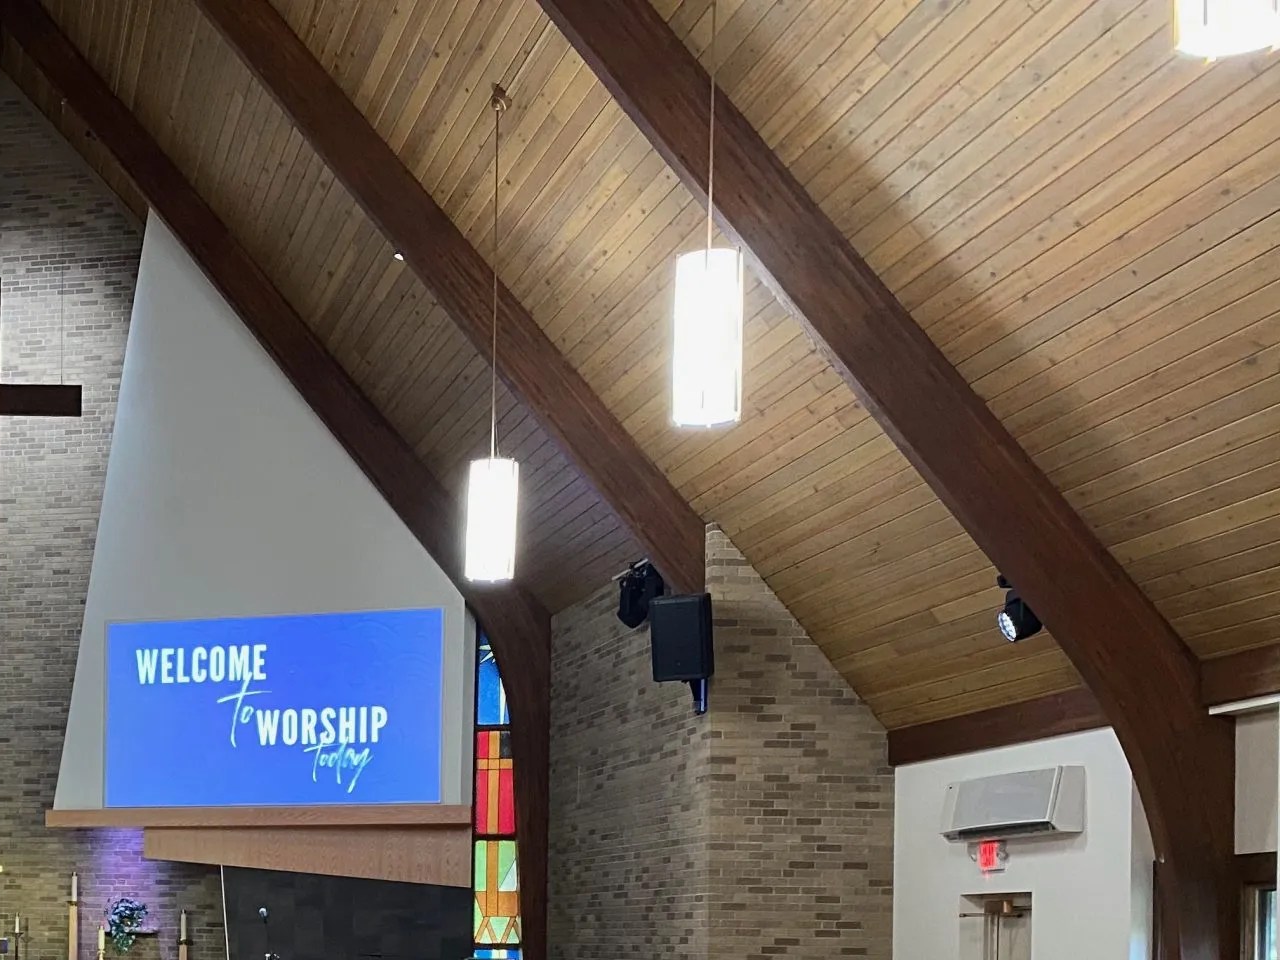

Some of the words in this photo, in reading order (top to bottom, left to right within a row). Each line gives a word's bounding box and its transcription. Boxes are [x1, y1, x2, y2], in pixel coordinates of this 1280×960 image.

[135, 643, 268, 685] WELCOME
[216, 671, 272, 748] to
[256, 705, 389, 746] WORSHIP
